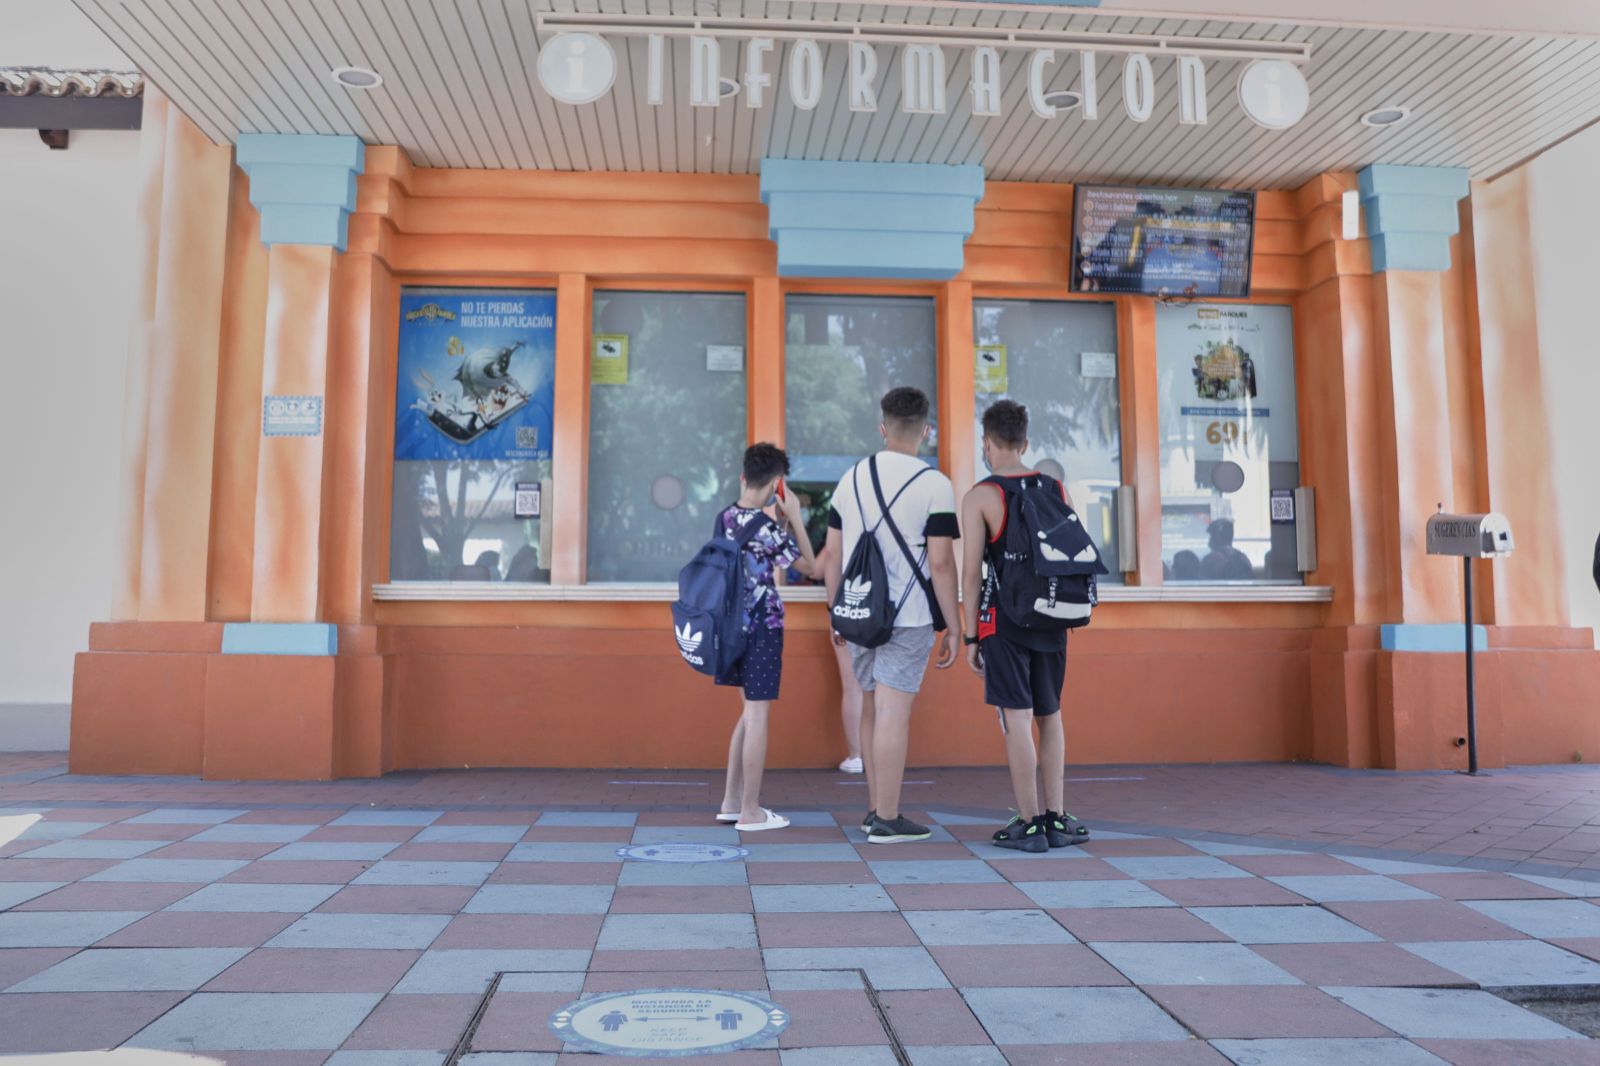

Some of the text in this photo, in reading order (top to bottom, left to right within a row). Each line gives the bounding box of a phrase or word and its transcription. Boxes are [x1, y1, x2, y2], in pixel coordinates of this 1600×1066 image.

[461, 302, 474, 314] NO
[476, 302, 486, 314] TE
[488, 302, 525, 314] PIERDAS
[461, 315, 500, 328] NUESTRA
[502, 313, 552, 328] APLICACIÓN
[1434, 520, 1477, 538] SUGERENCIAS
[833, 604, 871, 619] adidas
